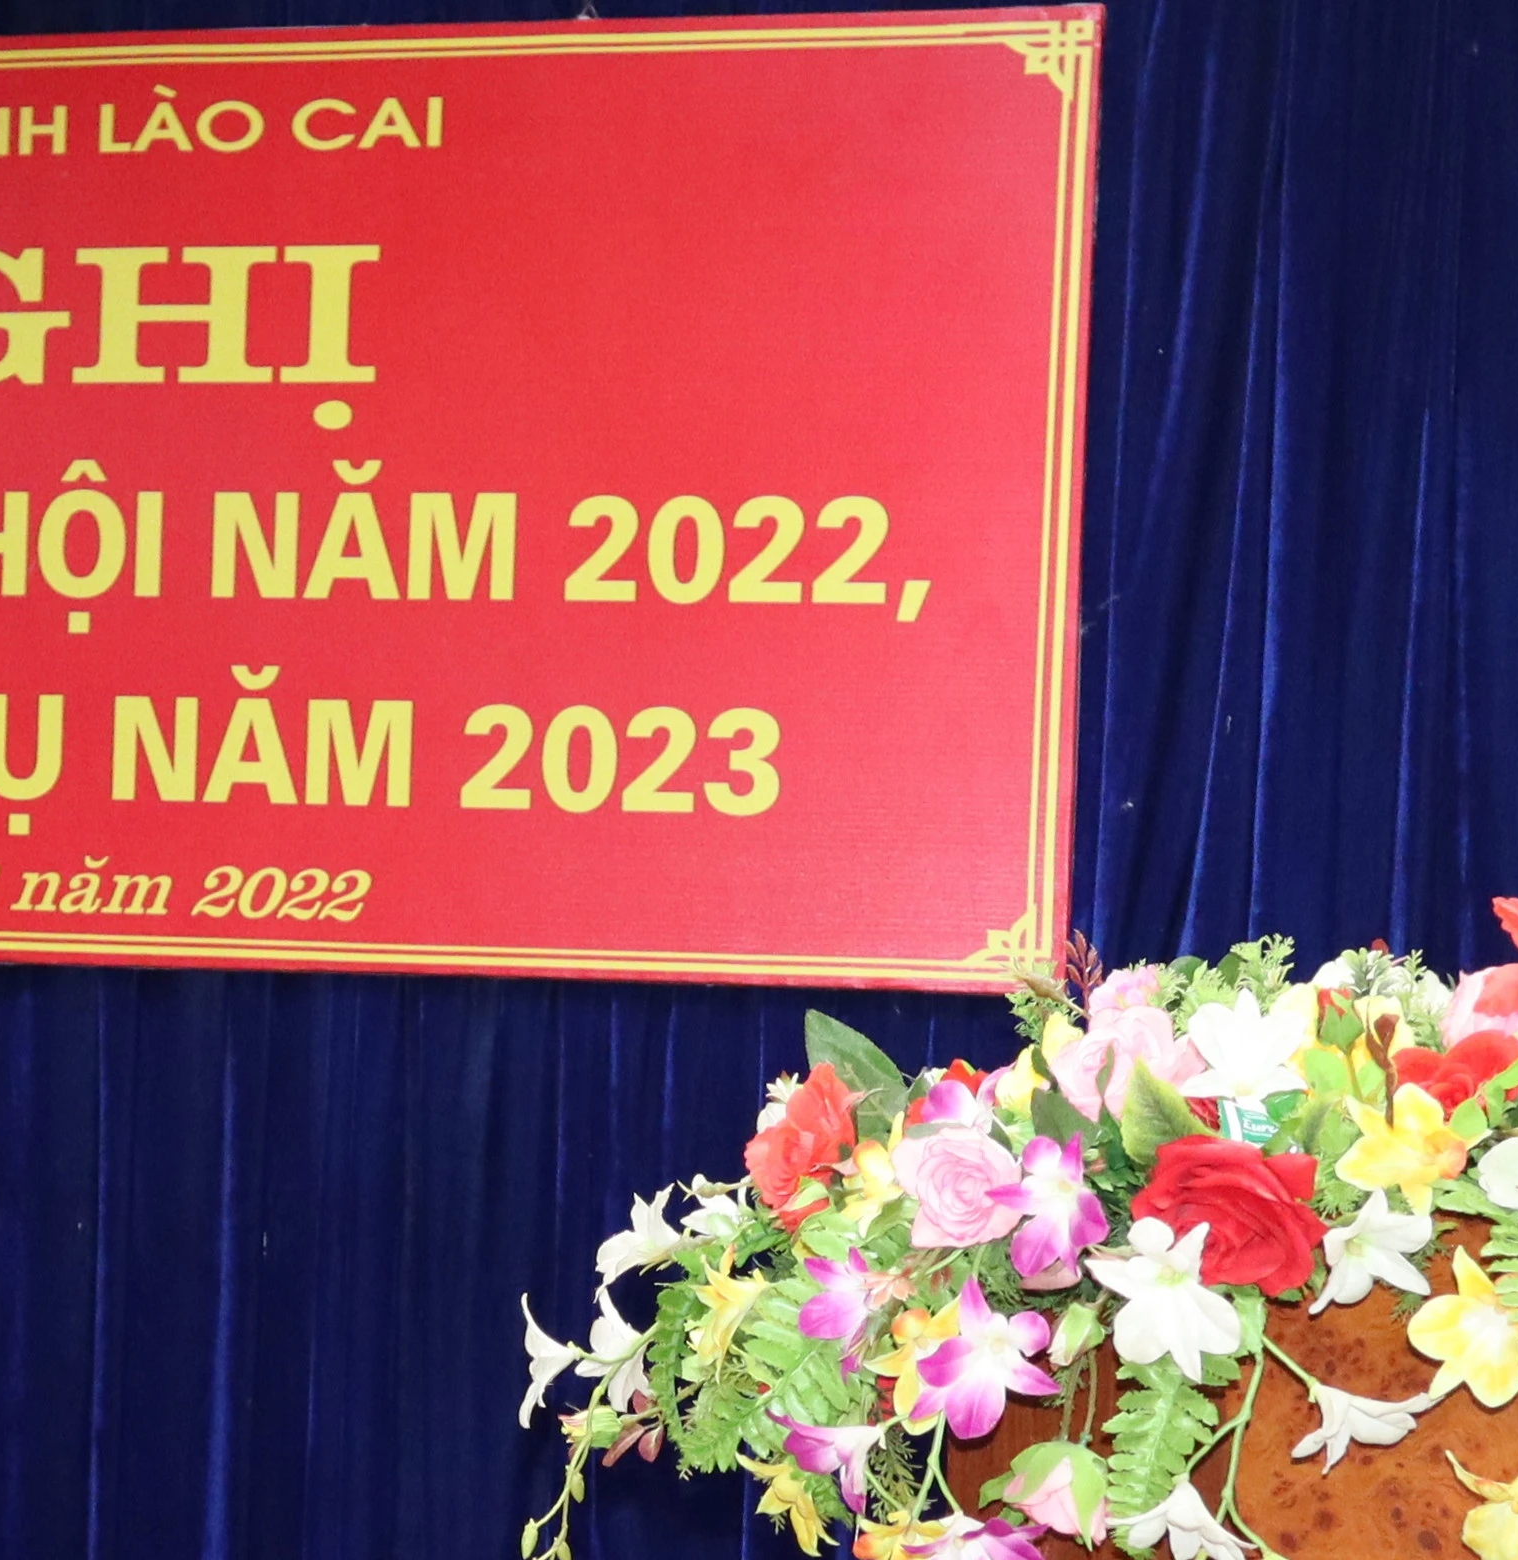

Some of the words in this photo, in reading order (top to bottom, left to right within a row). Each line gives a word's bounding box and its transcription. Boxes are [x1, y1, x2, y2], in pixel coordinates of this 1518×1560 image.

[98, 84, 265, 154] LÀO
[291, 96, 444, 152] CAI
[210, 458, 518, 602] NĂM
[563, 494, 933, 624] 2022,
[111, 664, 414, 809] NĂM
[459, 702, 783, 819] 2023
[9, 855, 173, 916] năm
[190, 864, 373, 923] 2022
